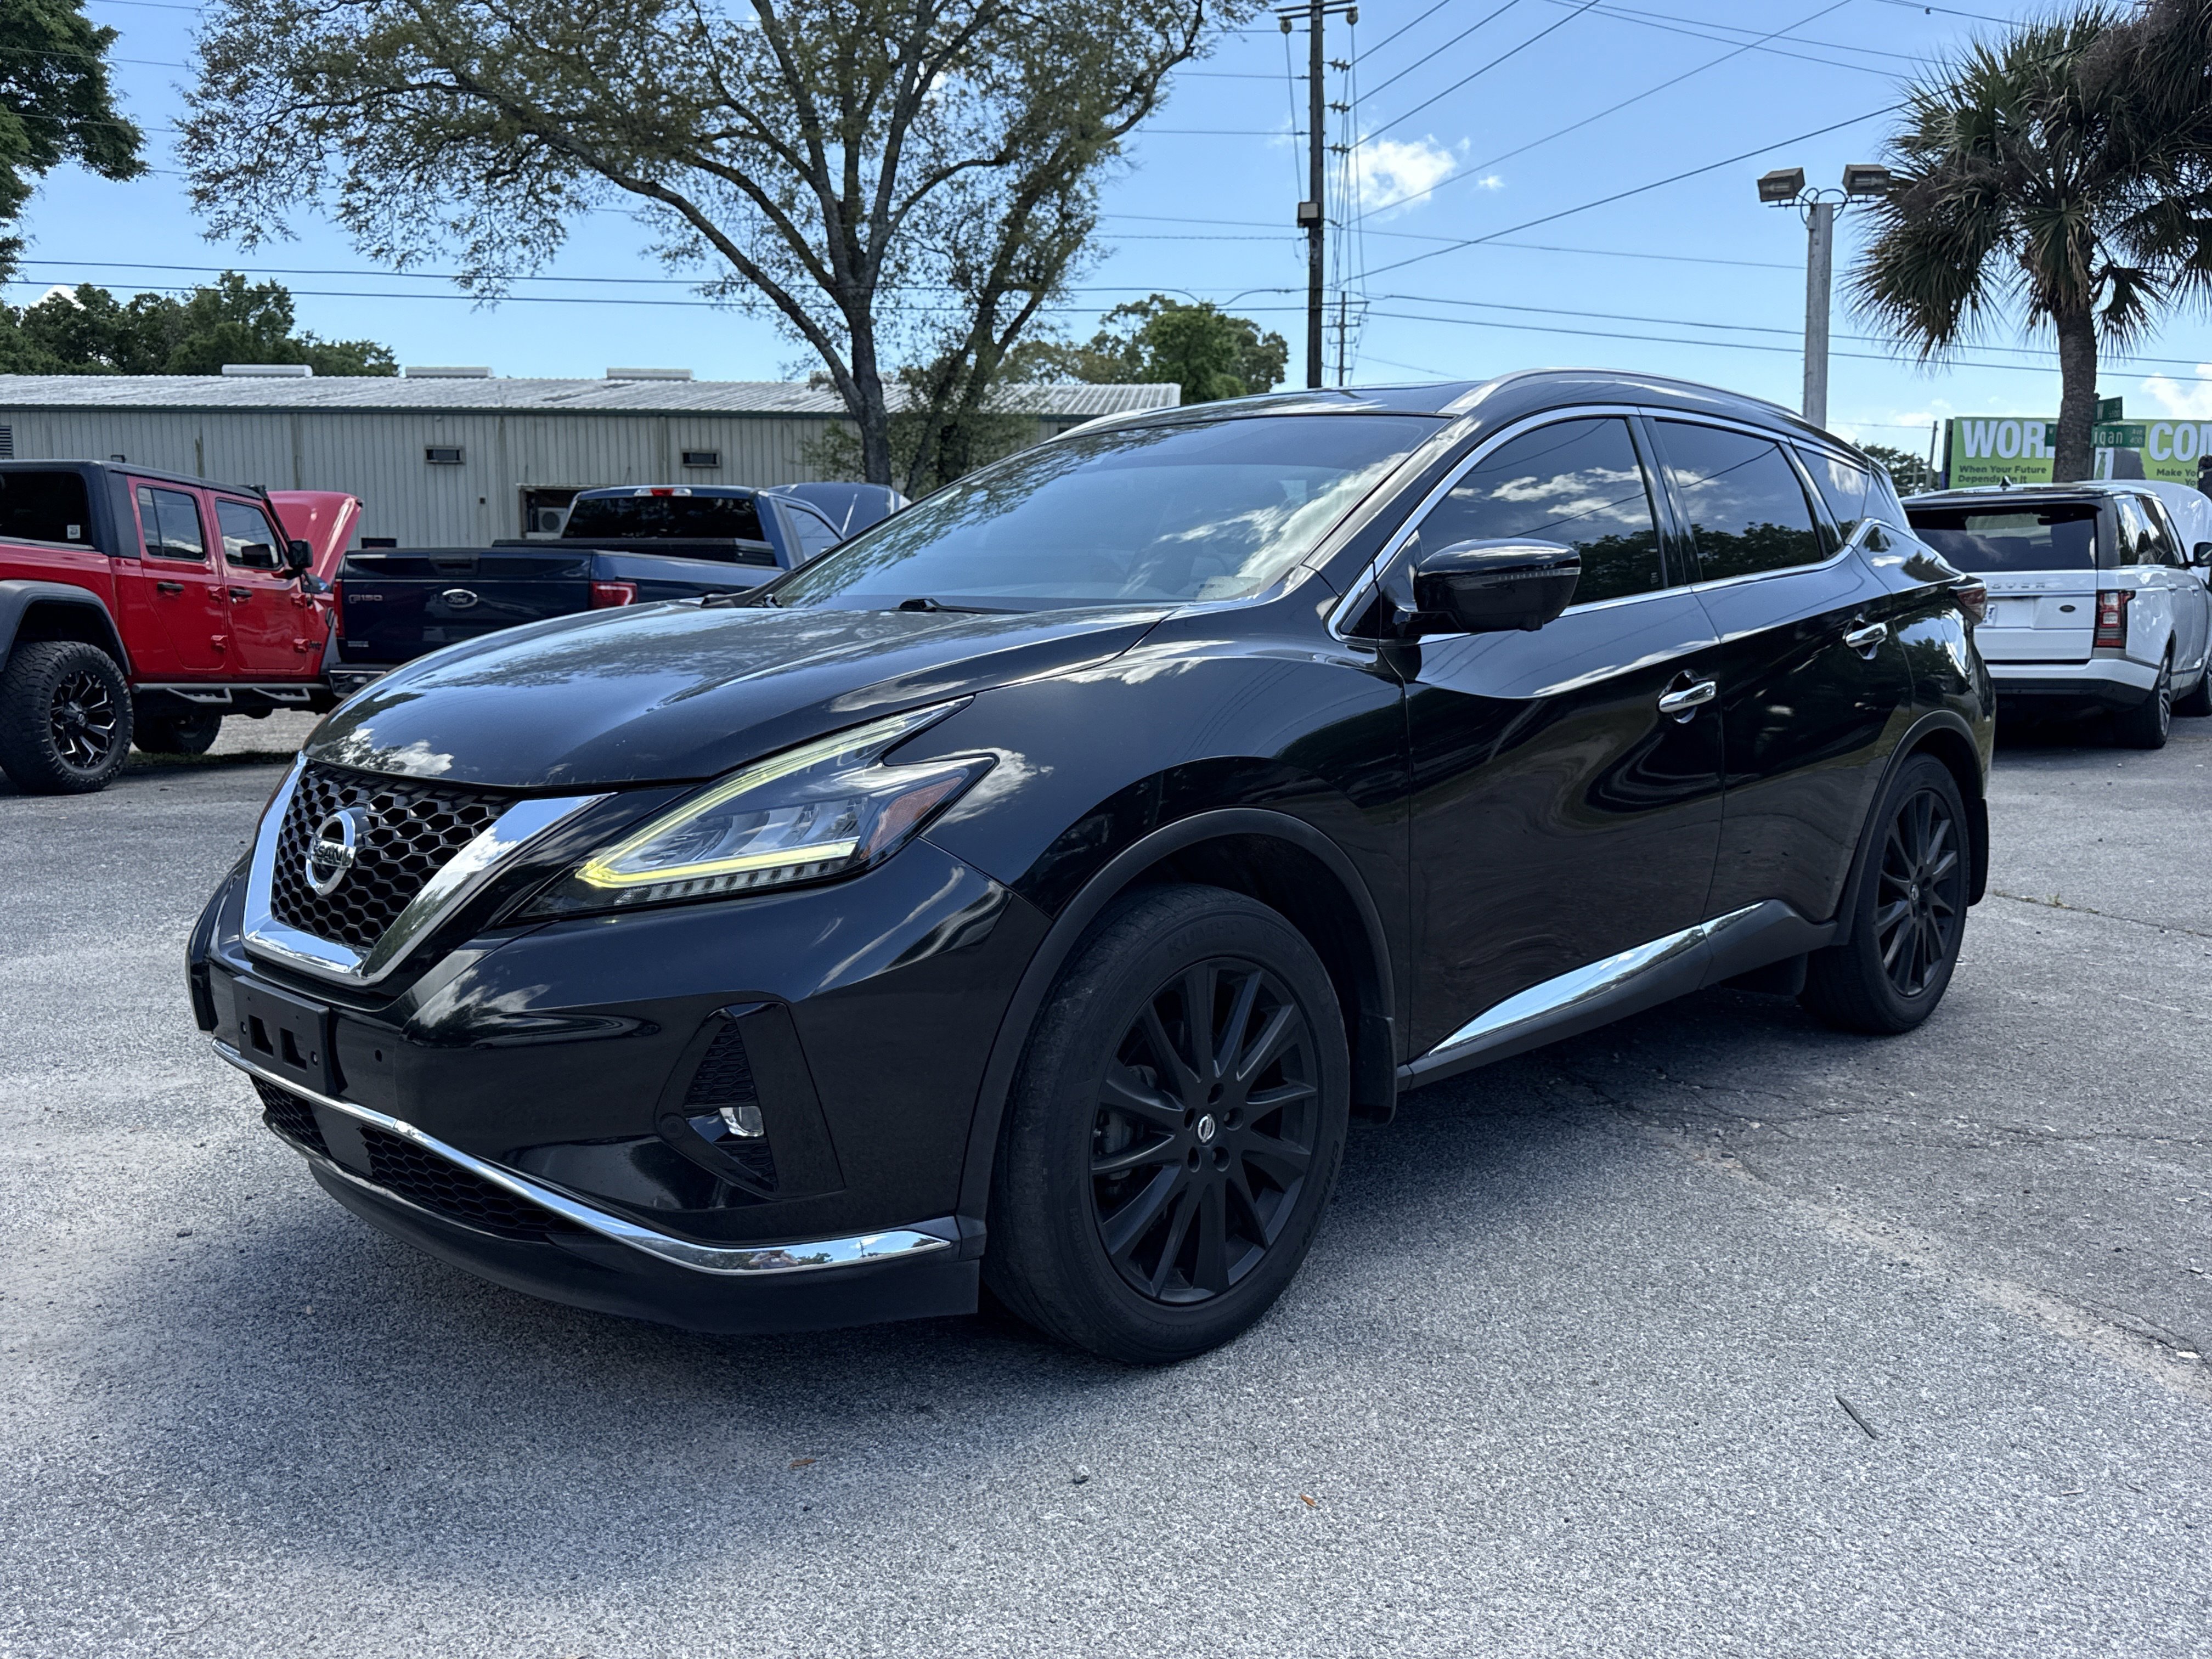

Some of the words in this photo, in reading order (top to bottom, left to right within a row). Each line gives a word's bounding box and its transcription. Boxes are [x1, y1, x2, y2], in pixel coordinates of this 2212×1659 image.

[1961, 420, 2055, 459] WOR
[1959, 465, 1987, 473] When
[1990, 465, 2012, 473] Your
[2015, 465, 2047, 473] Future
[2157, 468, 2182, 476] Make
[2185, 469, 2199, 477] Yo
[1958, 475, 2000, 483] Depends
[2020, 475, 2027, 483] It
